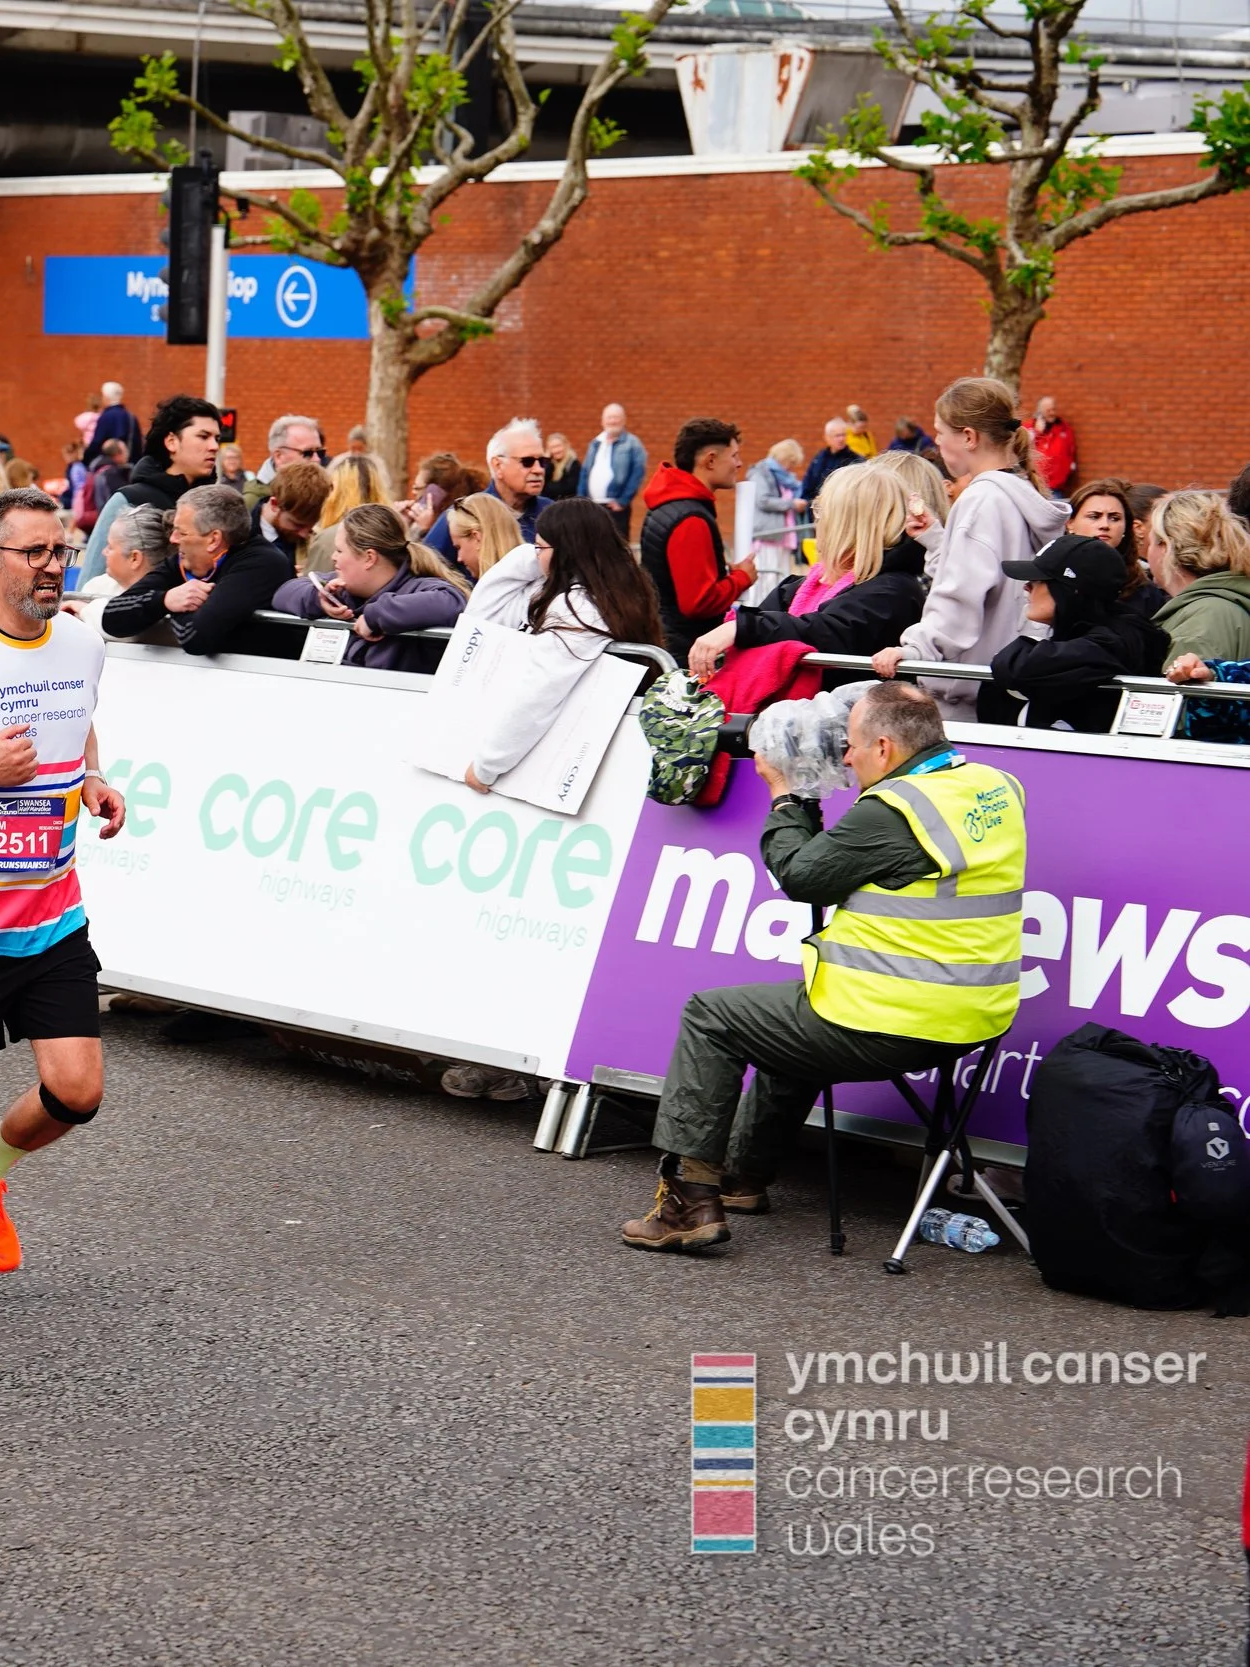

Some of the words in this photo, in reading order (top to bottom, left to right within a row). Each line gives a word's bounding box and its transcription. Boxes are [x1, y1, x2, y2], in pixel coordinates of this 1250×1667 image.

[462, 626, 484, 664] copy
[0, 680, 50, 699] ymchwil
[51, 679, 85, 692] canser
[0, 698, 39, 713] cymru
[1, 712, 42, 726] cancer
[42, 706, 87, 721] research
[558, 764, 579, 802] copy
[19, 799, 52, 807] SWANSEA
[976, 785, 1008, 804] Marathon
[980, 799, 1009, 816] Photos
[984, 815, 1002, 829] Live
[199, 773, 378, 872] core
[409, 803, 614, 909] core
[258, 867, 356, 911] highways
[476, 904, 588, 951] highways
